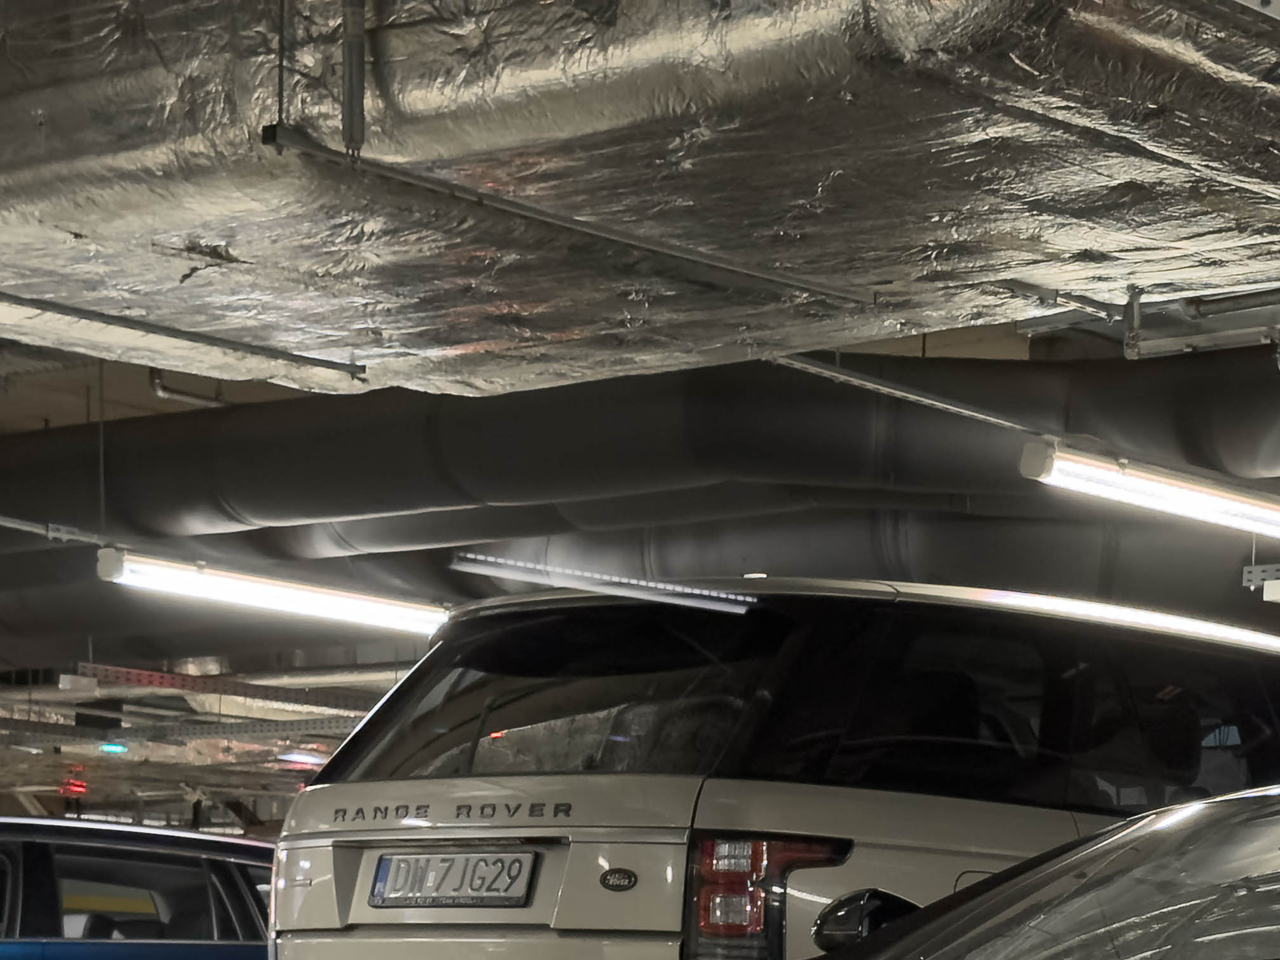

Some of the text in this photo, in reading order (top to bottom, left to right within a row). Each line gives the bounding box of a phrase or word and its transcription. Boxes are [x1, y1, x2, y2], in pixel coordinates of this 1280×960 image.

[333, 802, 573, 822] RANGE ROVER
[391, 857, 523, 893] DW 7JG29
